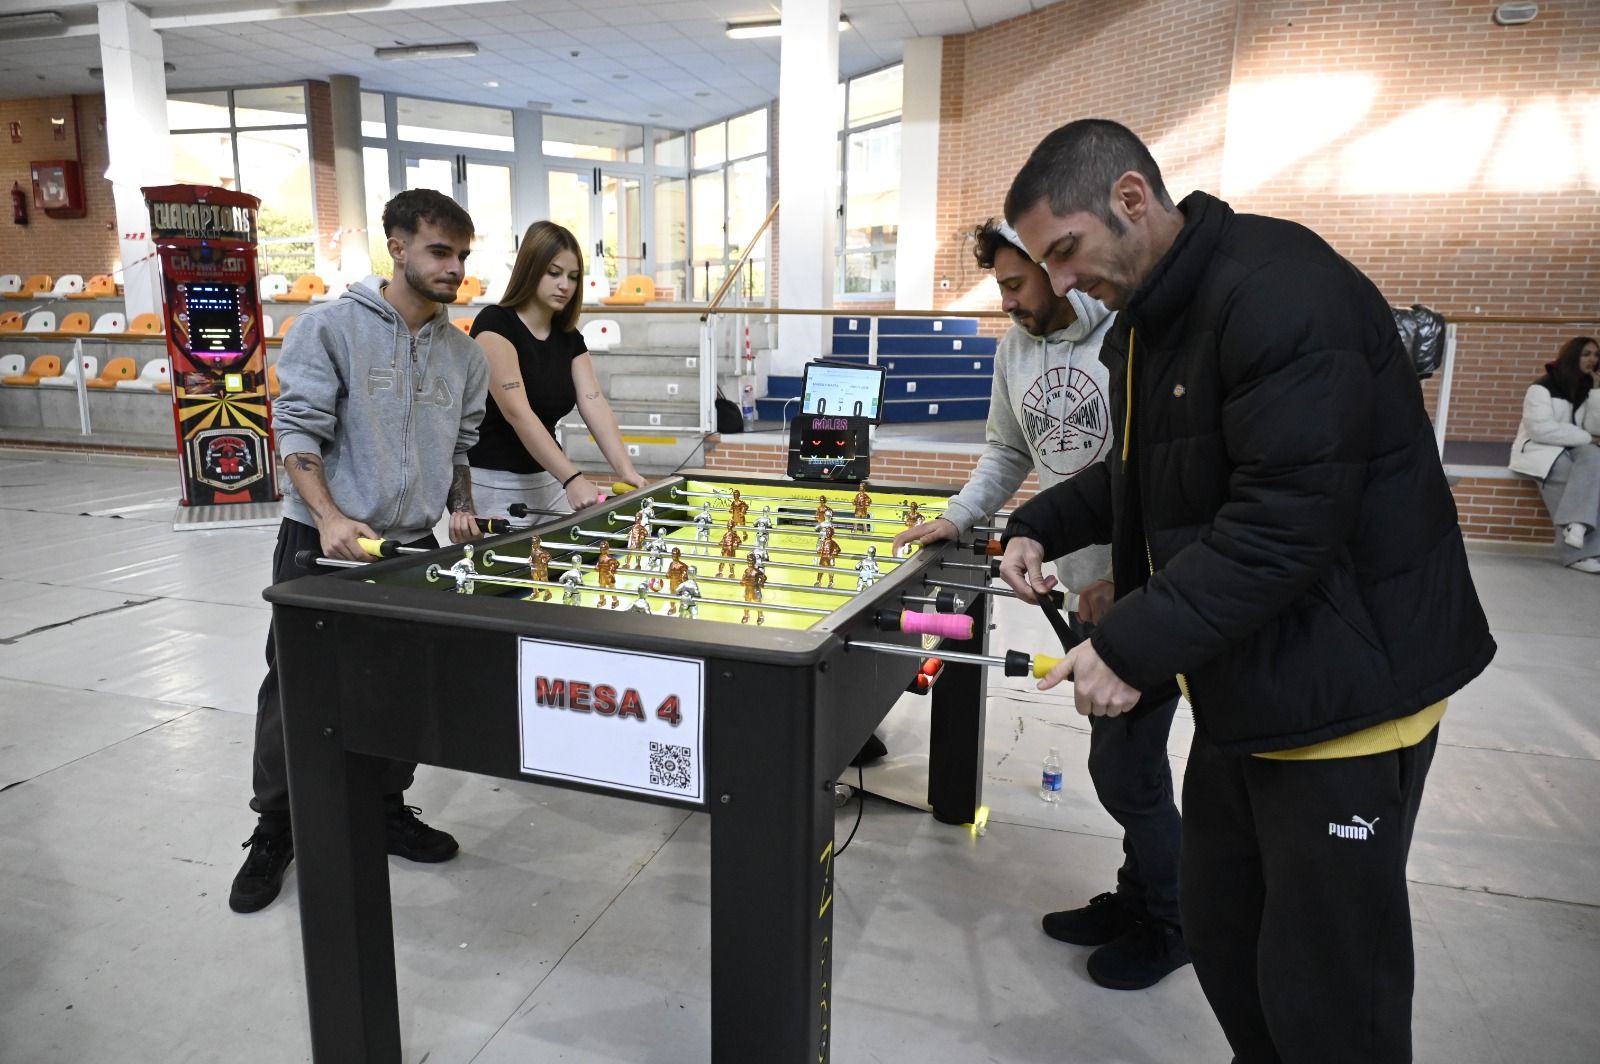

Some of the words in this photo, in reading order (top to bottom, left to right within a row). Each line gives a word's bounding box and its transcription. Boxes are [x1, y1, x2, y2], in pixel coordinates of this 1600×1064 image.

[153, 203, 250, 235] CHAMPIONS
[367, 367, 454, 410] FILA
[1069, 396, 1101, 431] COMPANY
[534, 675, 647, 723] MESA
[655, 693, 683, 728] 4
[1328, 822, 1368, 841] PUMA
